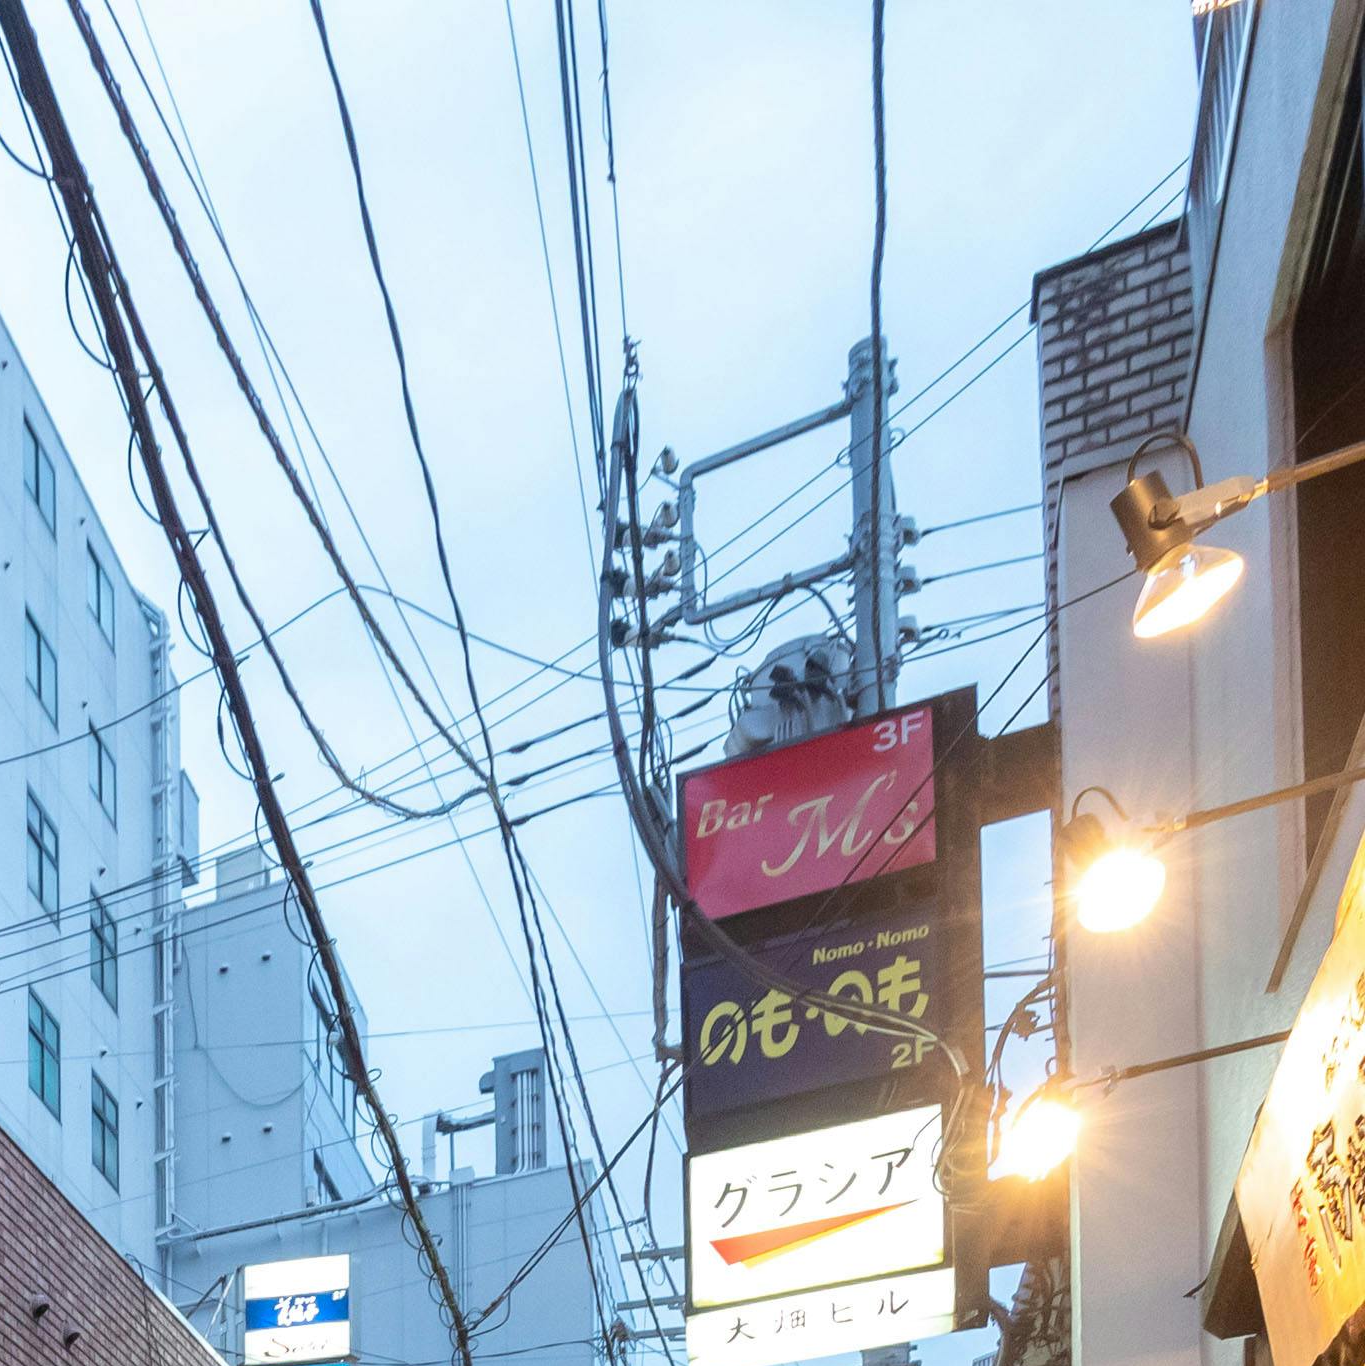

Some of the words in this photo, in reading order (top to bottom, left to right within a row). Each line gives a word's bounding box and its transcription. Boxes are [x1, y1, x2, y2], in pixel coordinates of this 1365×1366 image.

[873, 711, 924, 752] 3F
[696, 793, 773, 838] Bar
[761, 769, 919, 877] M's
[891, 1039, 935, 1069] 2F
[714, 1147, 912, 1229] グラシア
